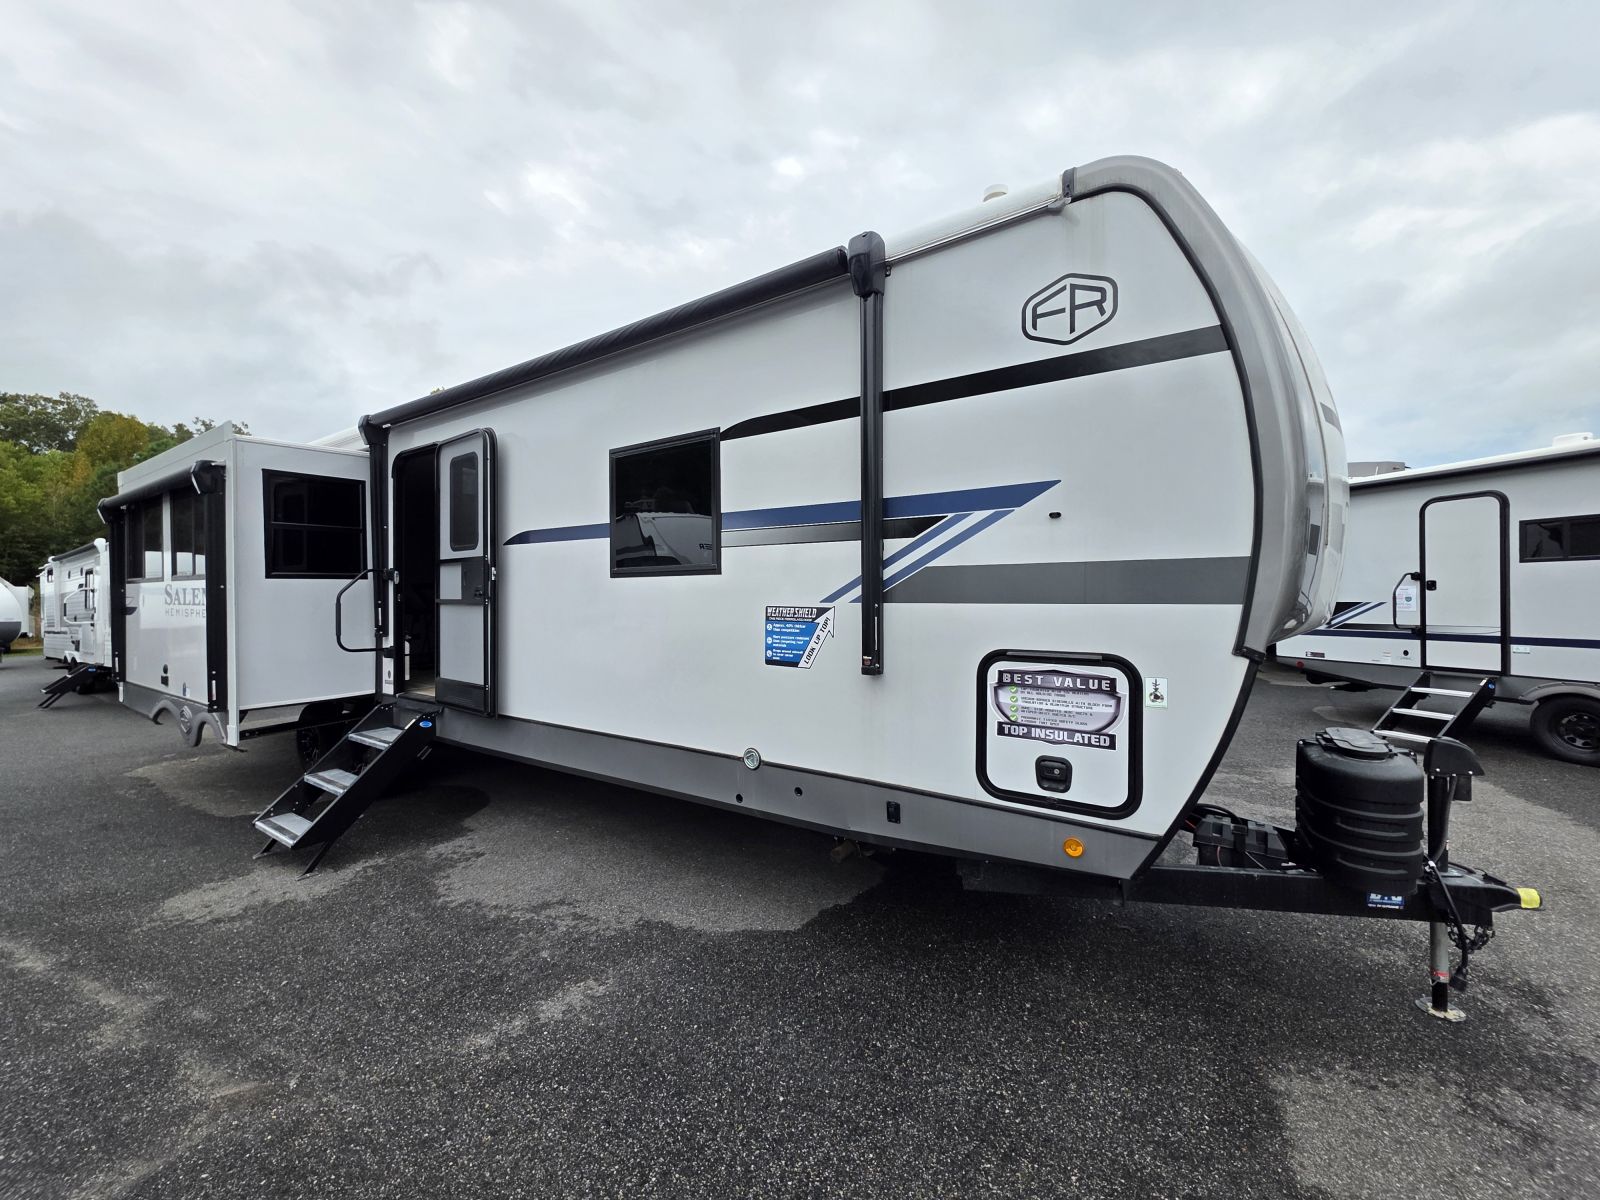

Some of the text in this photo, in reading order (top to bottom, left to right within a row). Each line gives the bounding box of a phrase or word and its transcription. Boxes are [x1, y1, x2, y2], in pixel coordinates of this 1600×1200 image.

[1032, 283, 1107, 334] FR
[804, 647, 816, 664] LOOK
[814, 635, 821, 645] UP
[1002, 674, 1111, 691] BEST VALUE
[1002, 723, 1110, 747] TOP INSULATED
